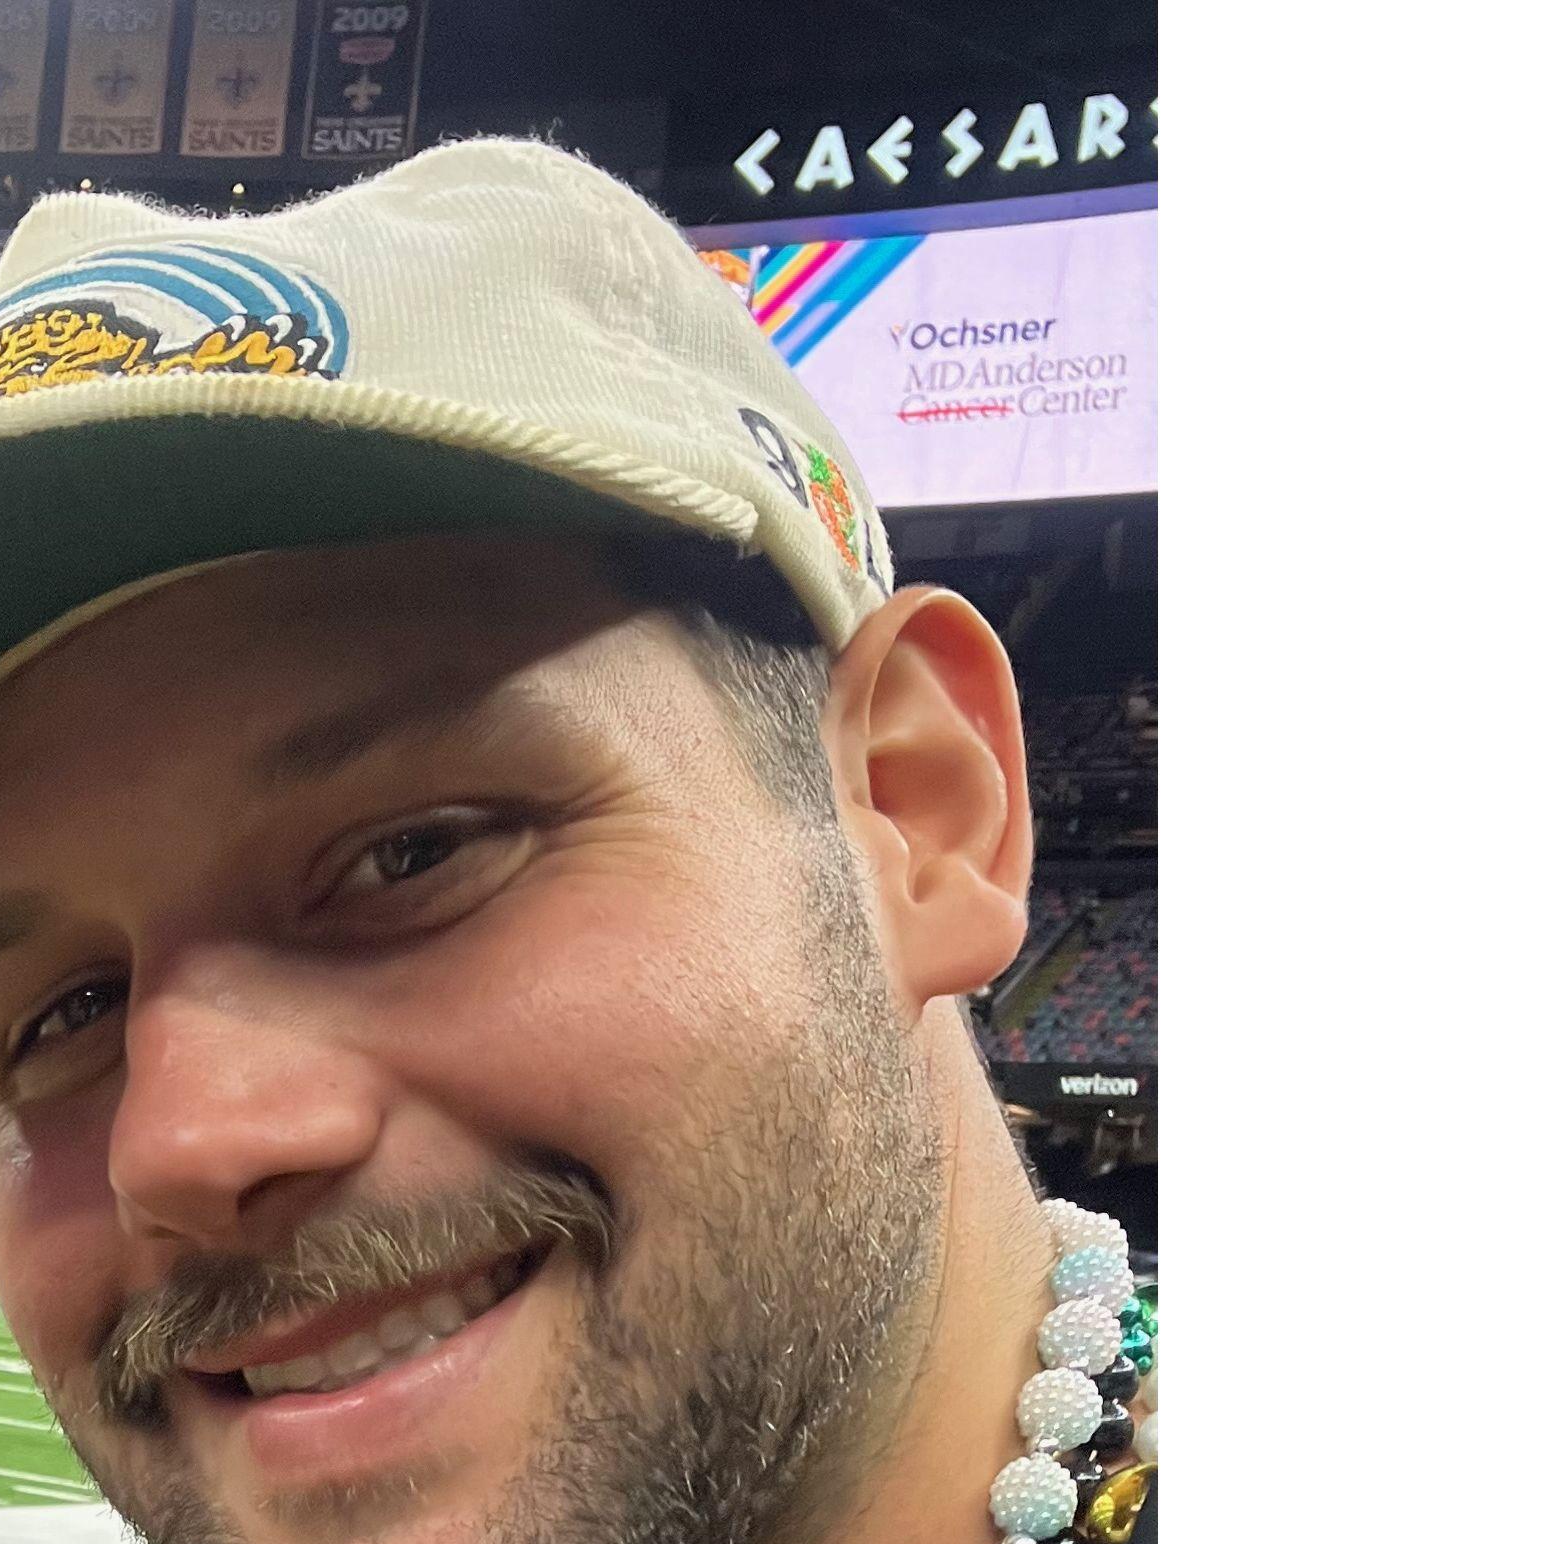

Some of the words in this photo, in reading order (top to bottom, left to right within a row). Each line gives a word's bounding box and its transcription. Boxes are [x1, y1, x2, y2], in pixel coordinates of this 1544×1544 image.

[330, 5, 408, 32] 2009
[187, 127, 278, 151] SAINTS
[313, 127, 403, 151] SAINTS
[733, 93, 1158, 197] CAESAR
[910, 317, 1058, 351] Ochsner
[1017, 383, 1129, 419] Center
[1059, 1072, 1139, 1097] verizon
